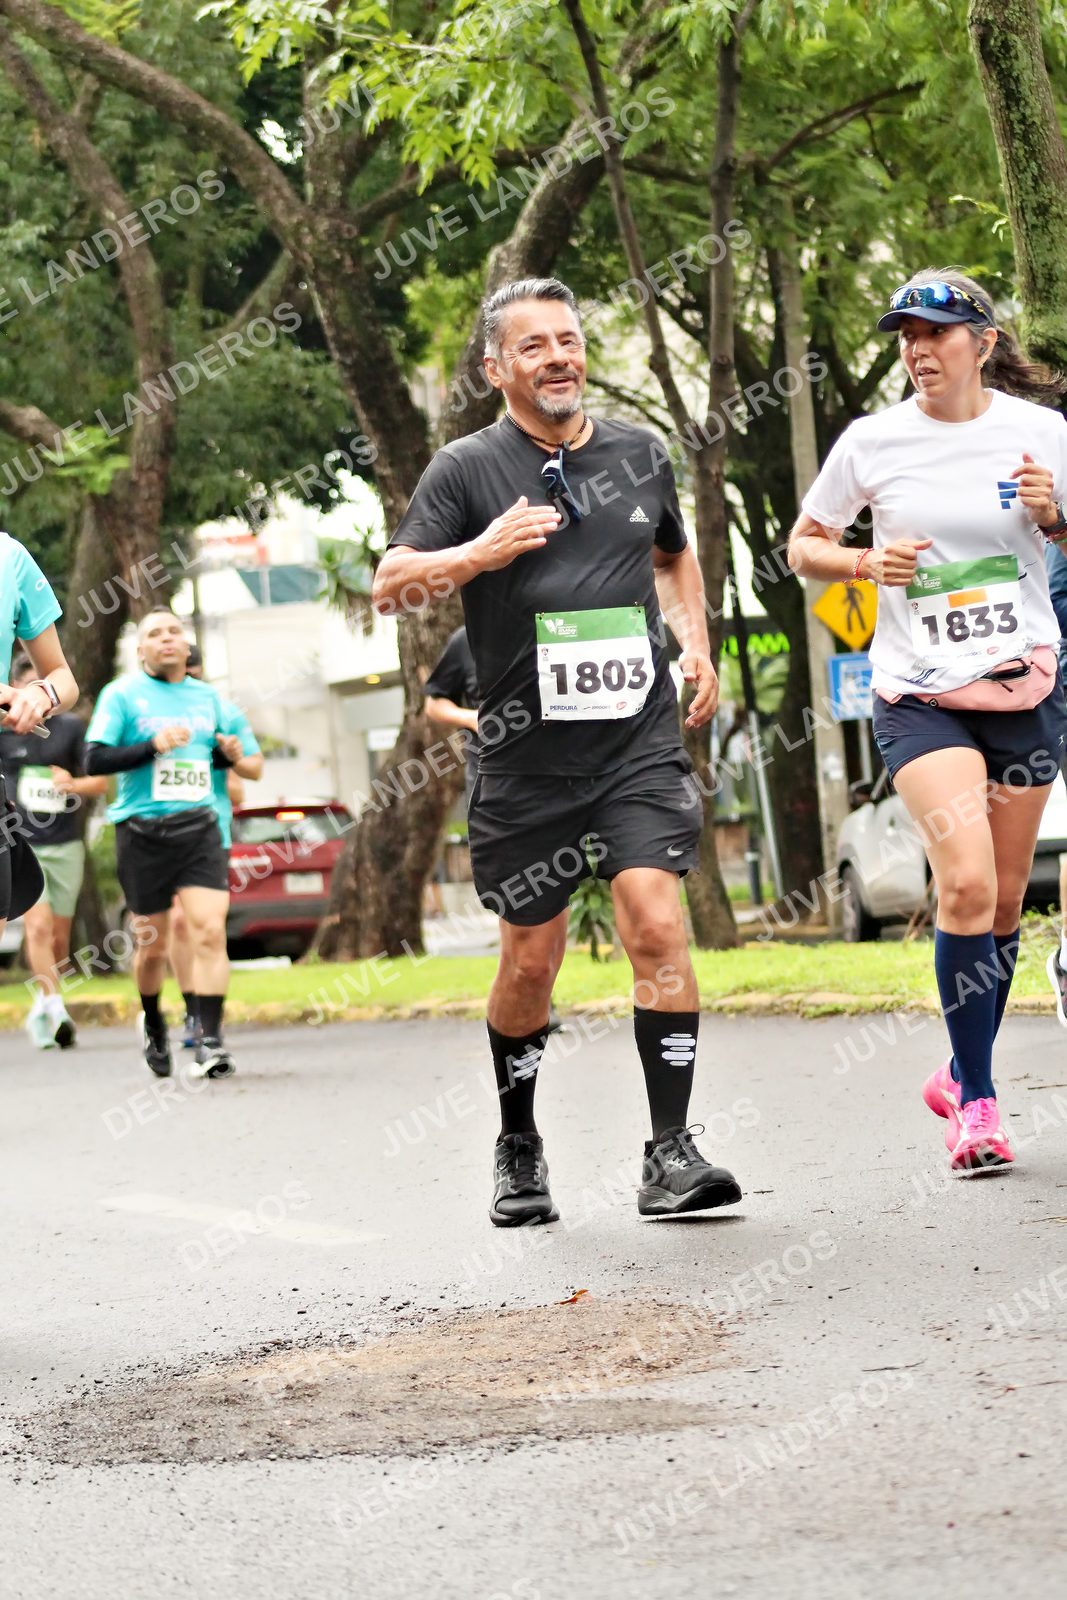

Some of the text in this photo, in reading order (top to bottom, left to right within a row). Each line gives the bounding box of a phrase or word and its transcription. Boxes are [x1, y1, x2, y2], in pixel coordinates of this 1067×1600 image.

[921, 602, 1018, 646] 1833
[550, 657, 648, 696] 1803
[159, 768, 208, 787] 2505
